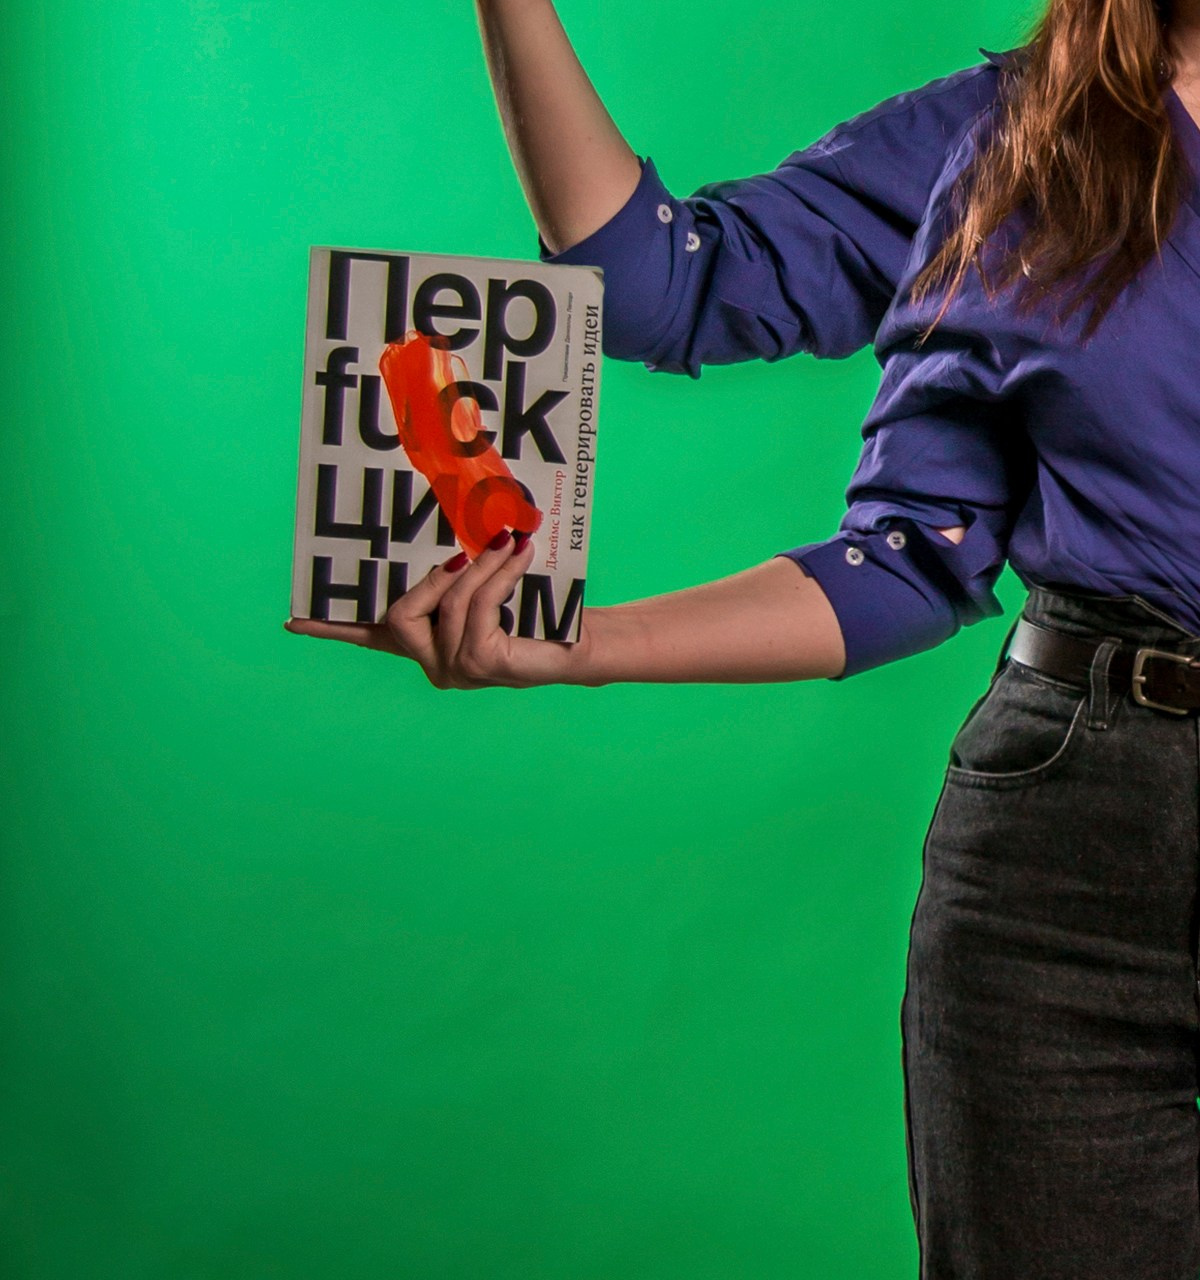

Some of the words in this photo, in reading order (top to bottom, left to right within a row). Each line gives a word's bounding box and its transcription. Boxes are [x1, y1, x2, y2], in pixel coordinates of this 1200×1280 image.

[325, 250, 558, 381] Пер
[584, 305, 600, 356] идеи
[315, 346, 571, 465] fuck
[574, 360, 596, 507] генерировать
[549, 470, 566, 516] Виктор
[545, 521, 562, 570] Джеймс
[569, 511, 586, 552] как
